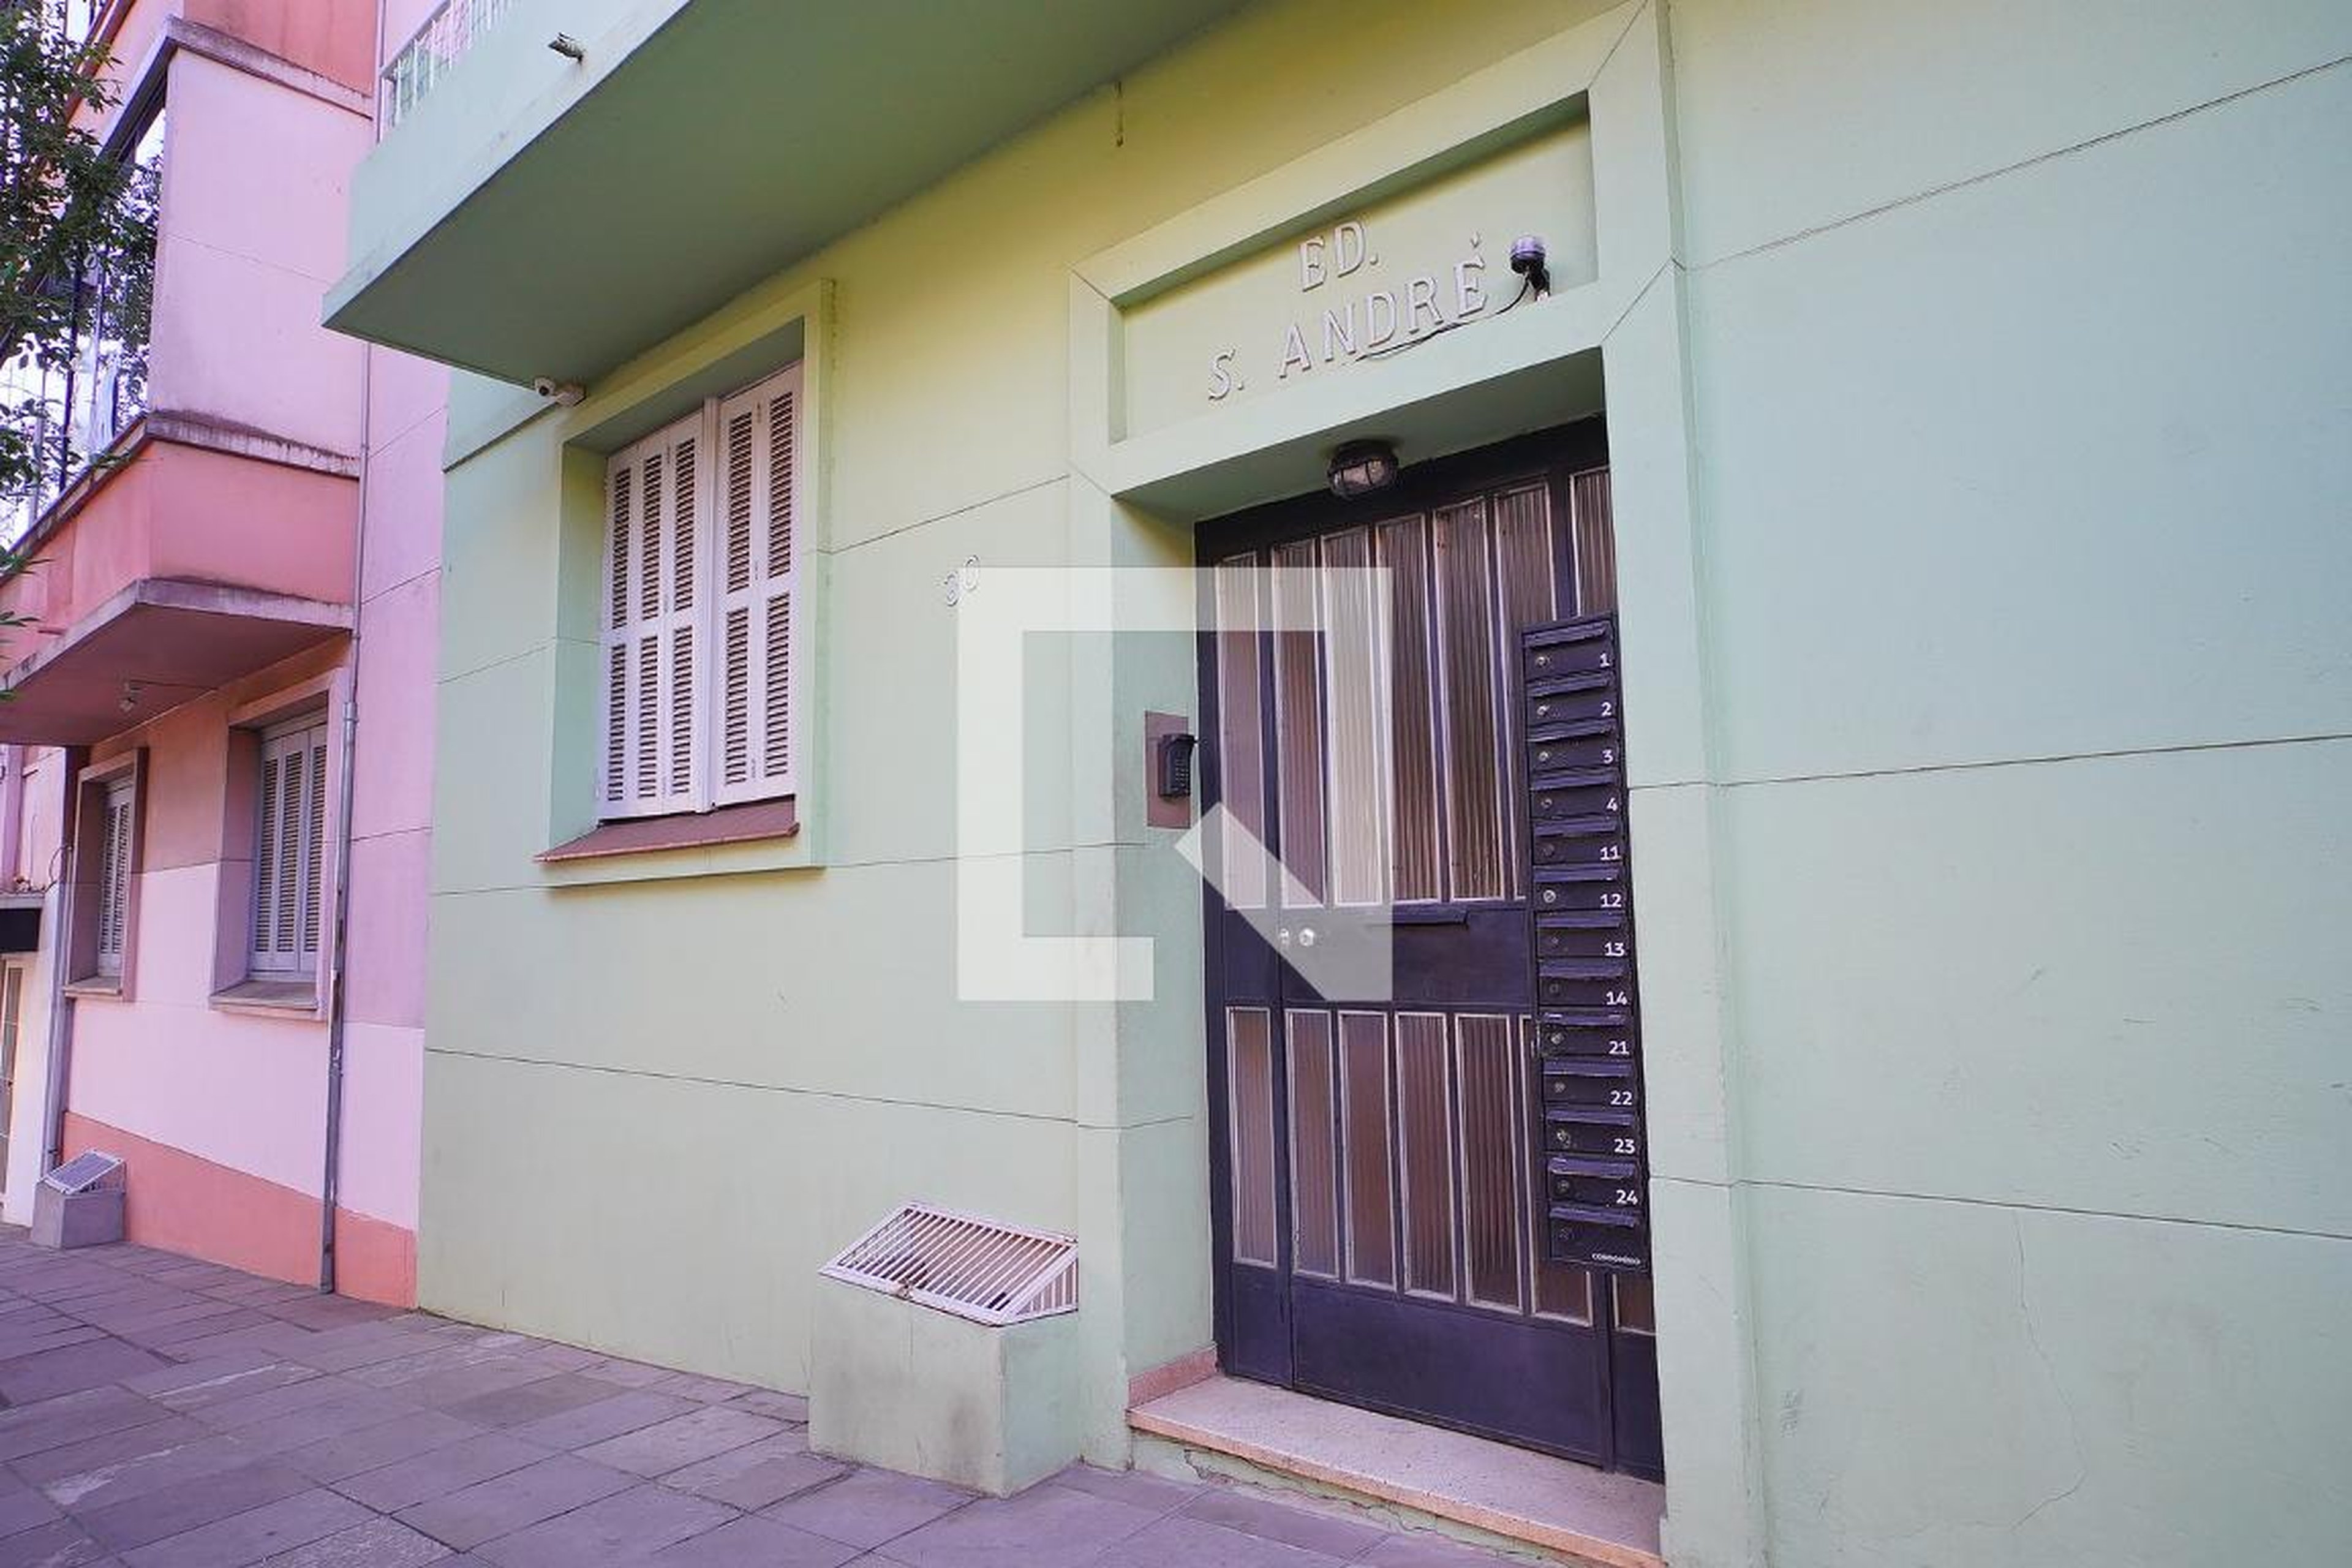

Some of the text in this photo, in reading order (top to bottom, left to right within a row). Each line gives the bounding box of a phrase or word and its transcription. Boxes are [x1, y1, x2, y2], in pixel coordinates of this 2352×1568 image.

[1298, 220, 1379, 292] ED.
[1207, 230, 1488, 401] S. ANDRÉ
[1600, 652, 1611, 668] 1
[1601, 701, 1612, 717] 2
[1602, 749, 1614, 764] 3
[1606, 797, 1618, 812] 4
[1600, 845, 1621, 861] 11
[1600, 893, 1623, 908] 12
[1604, 941, 1626, 957] 13
[1606, 991, 1627, 1005] 14
[1608, 1041, 1630, 1055] 21
[1610, 1090, 1633, 1106] 22
[1614, 1139, 1636, 1154] 23
[1616, 1189, 1638, 1205] 24
